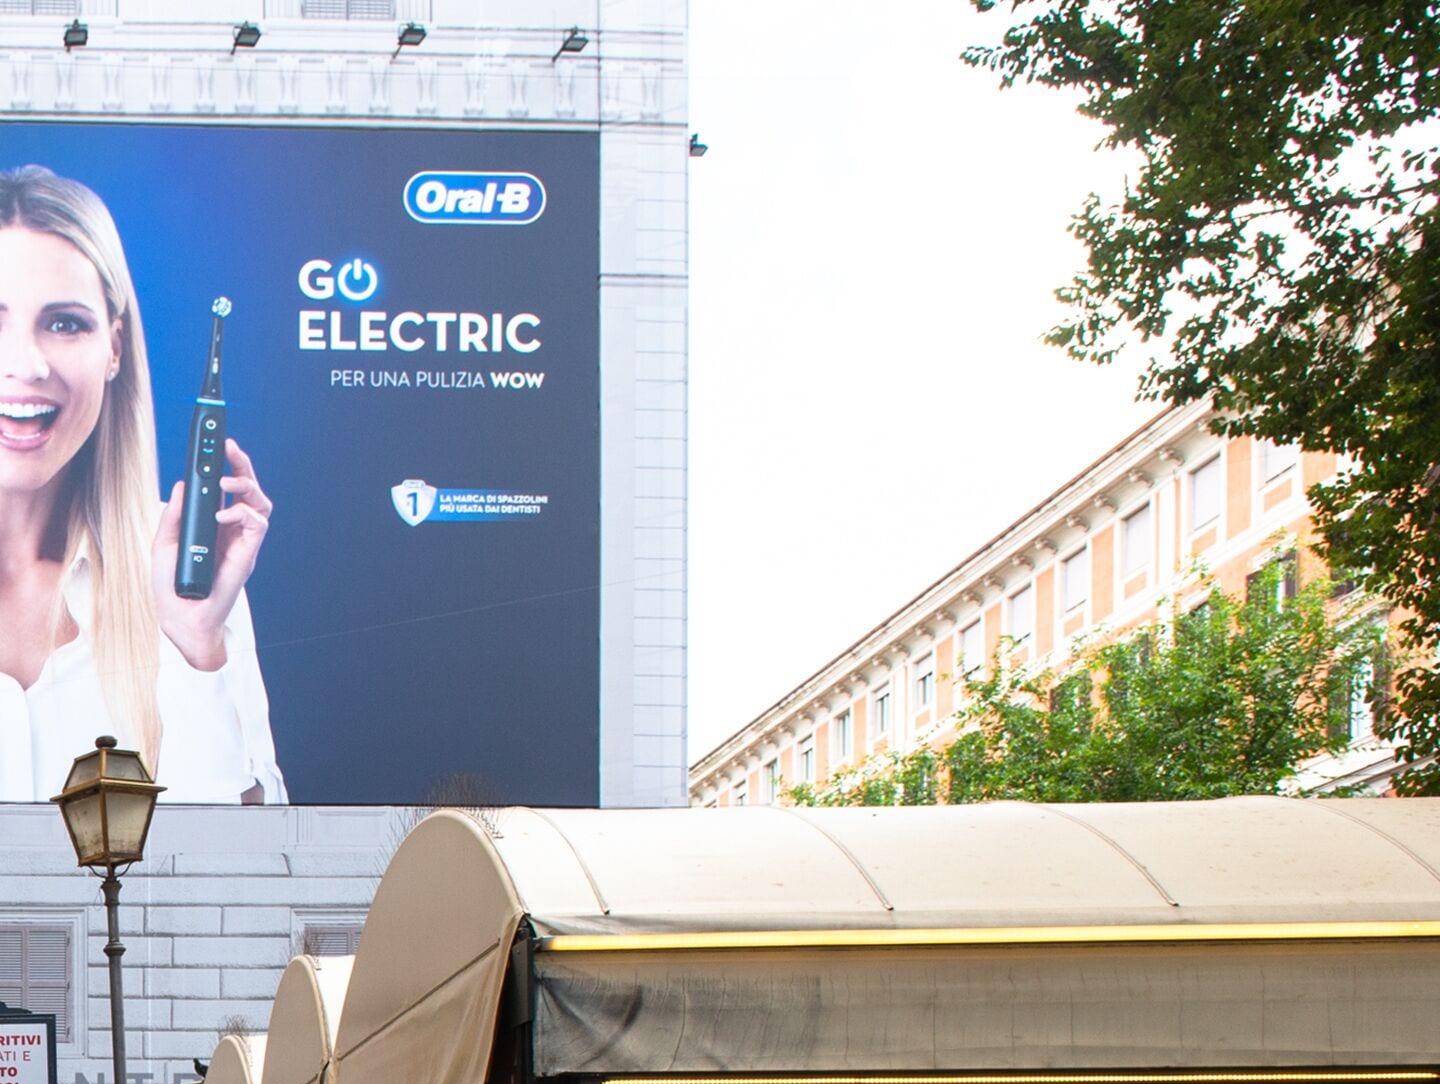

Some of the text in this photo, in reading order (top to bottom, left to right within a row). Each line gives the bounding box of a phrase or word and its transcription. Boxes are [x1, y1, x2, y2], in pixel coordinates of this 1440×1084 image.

[415, 181, 531, 215] Oral-B
[298, 258, 378, 301] GO
[299, 310, 541, 353] ELECTRIC
[330, 370, 544, 389] PER UNA PULIZIA WOW
[407, 492, 418, 517] 1
[440, 495, 548, 504] LA MARCA DI SPAZZOLINI
[456, 505, 483, 513] USATA
[485, 505, 500, 513] DAI
[501, 505, 541, 514] DENTISTI
[23, 1051, 31, 1062] E
